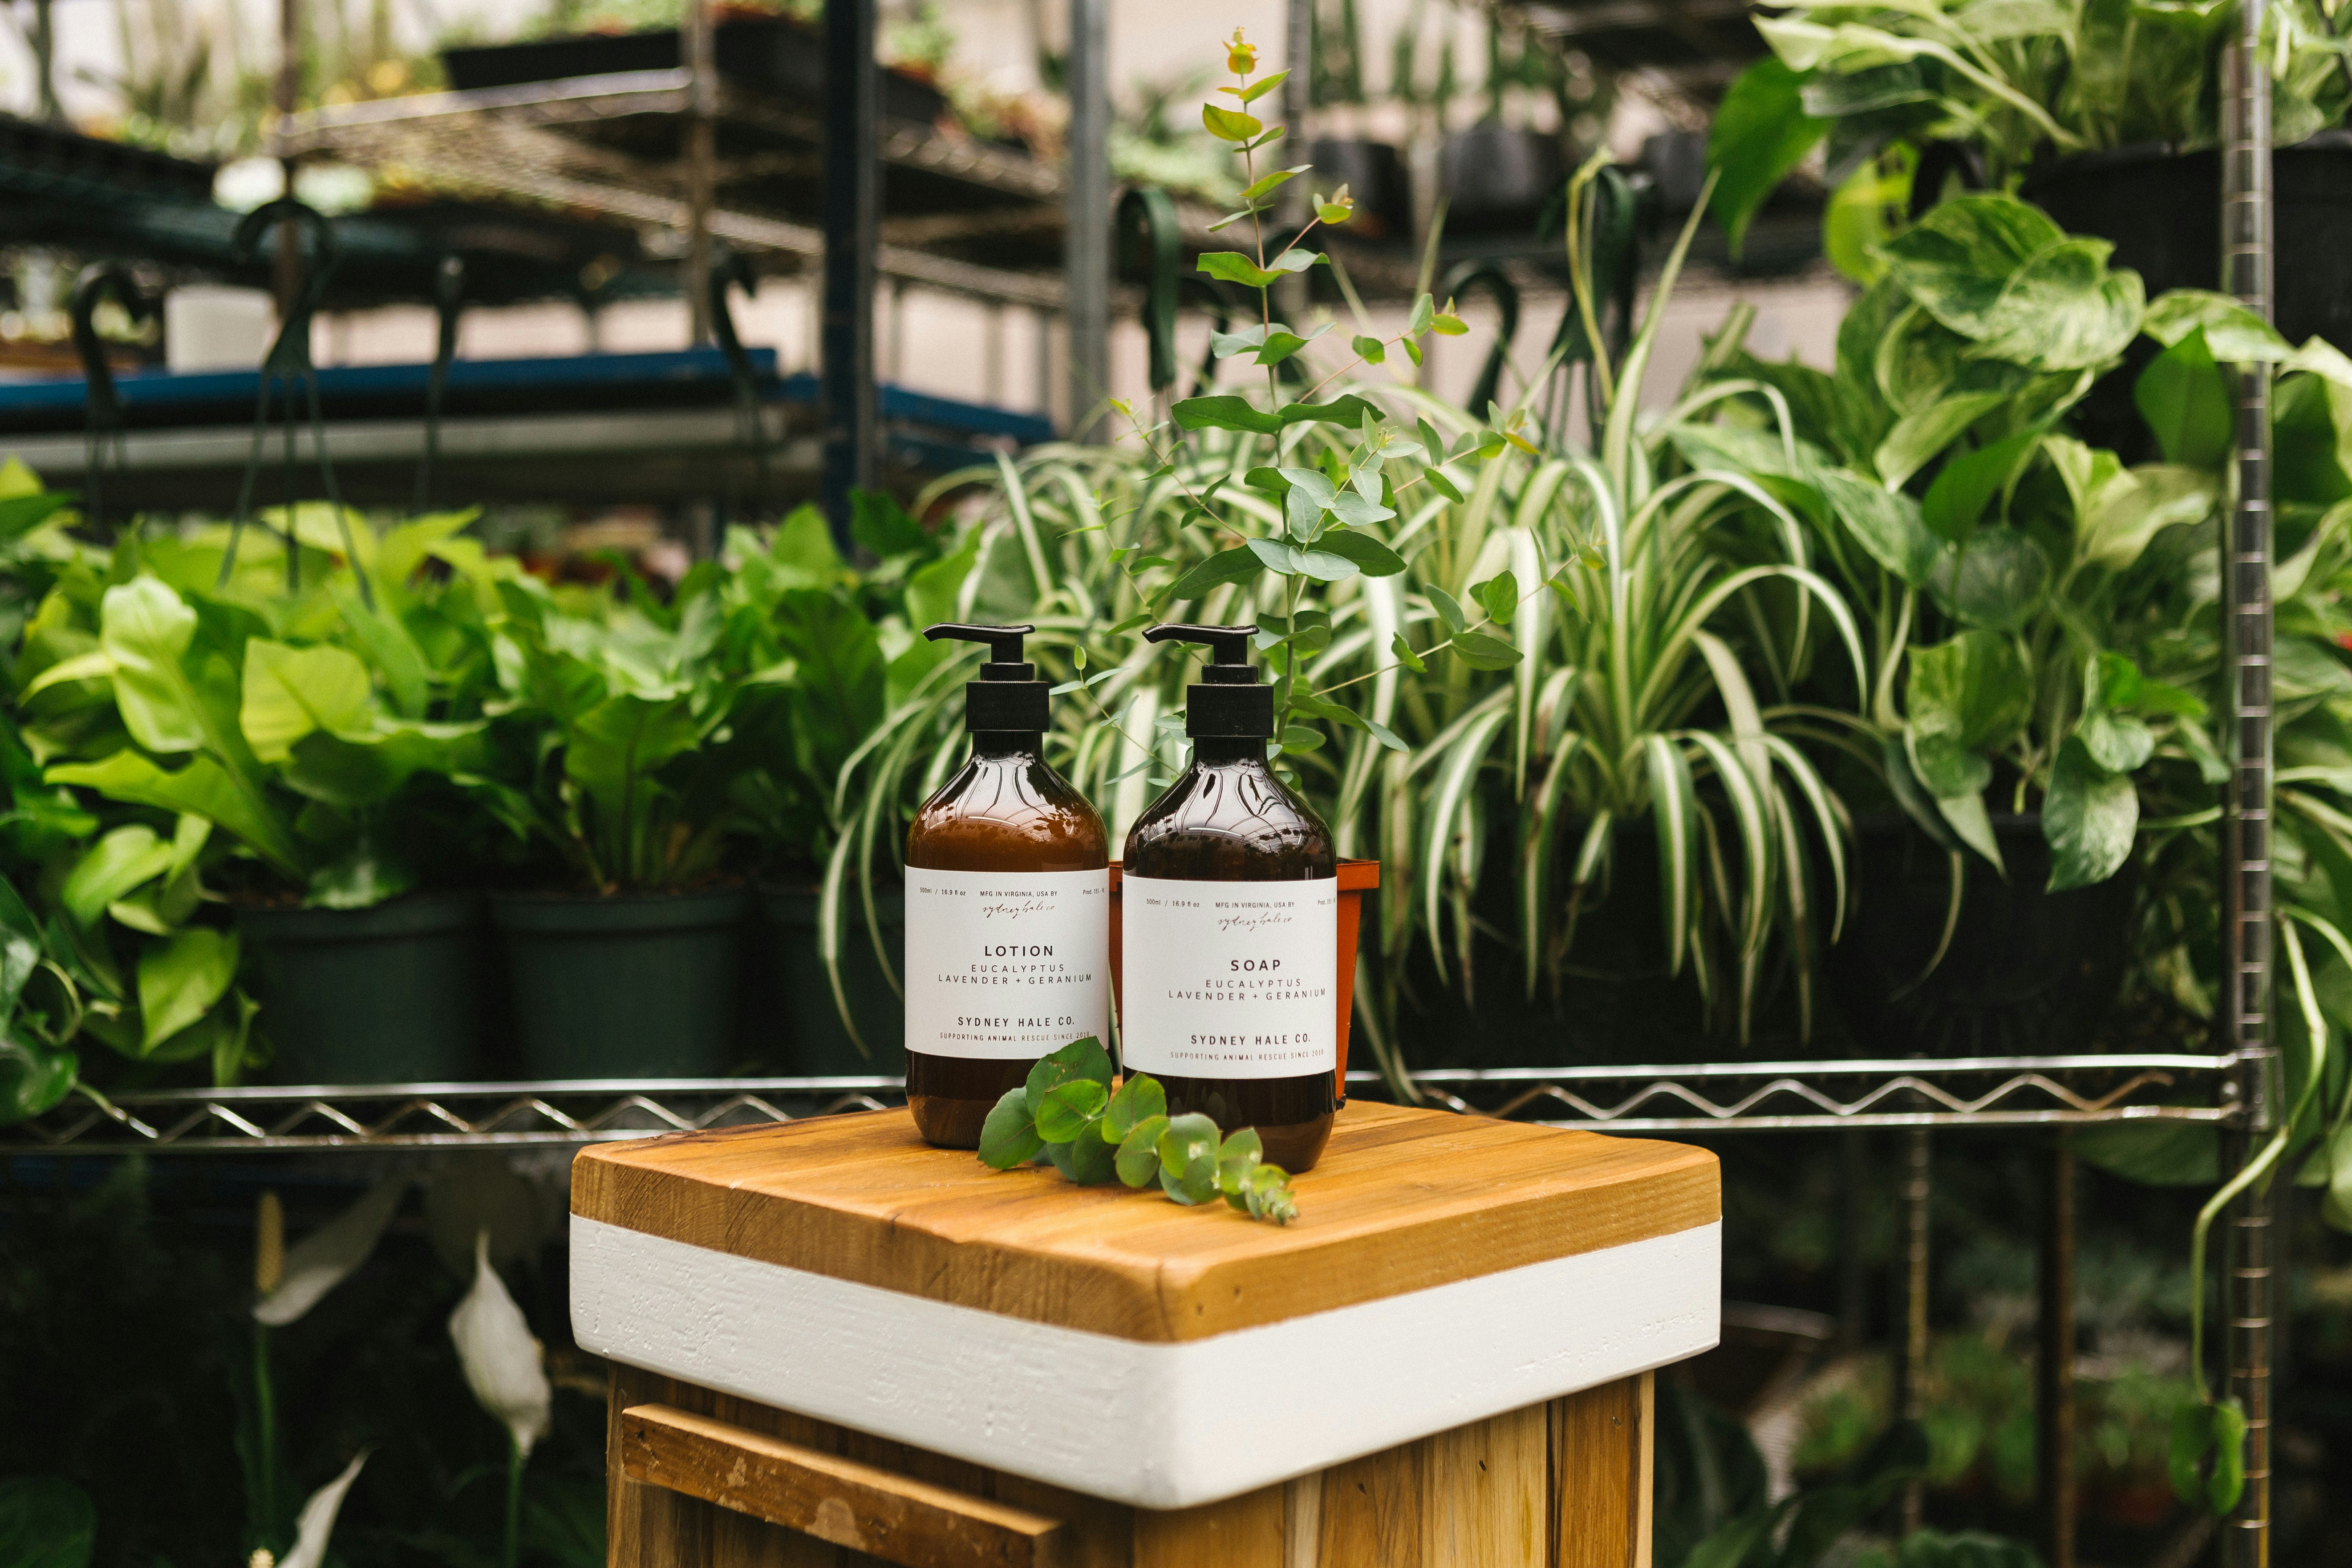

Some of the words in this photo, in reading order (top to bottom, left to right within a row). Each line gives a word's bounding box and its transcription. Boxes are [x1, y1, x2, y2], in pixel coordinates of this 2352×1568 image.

[985, 945, 1053, 956] LOTION
[971, 964, 1064, 973] EUCALYPTUS
[1231, 960, 1280, 971] SOAP
[938, 974, 1008, 985] LAVENDER
[1028, 973, 1091, 985] GERANIUM
[1206, 978, 1300, 989] EUCALYPTUS
[1169, 990, 1245, 1001] LAVENDER
[1266, 988, 1325, 1001] GERANIUM
[958, 1017, 1009, 1027] SYDNEY
[1018, 1017, 1050, 1027] HALE
[1058, 1016, 1075, 1026] CO.
[940, 1032, 983, 1041] SUPPORTING
[1191, 1035, 1245, 1045] SYDNEY
[1255, 1035, 1287, 1045] HALE
[1295, 1033, 1310, 1044] CO.
[1170, 1052, 1219, 1061] SUPPORTING
[1312, 1049, 1324, 1057] 2010
